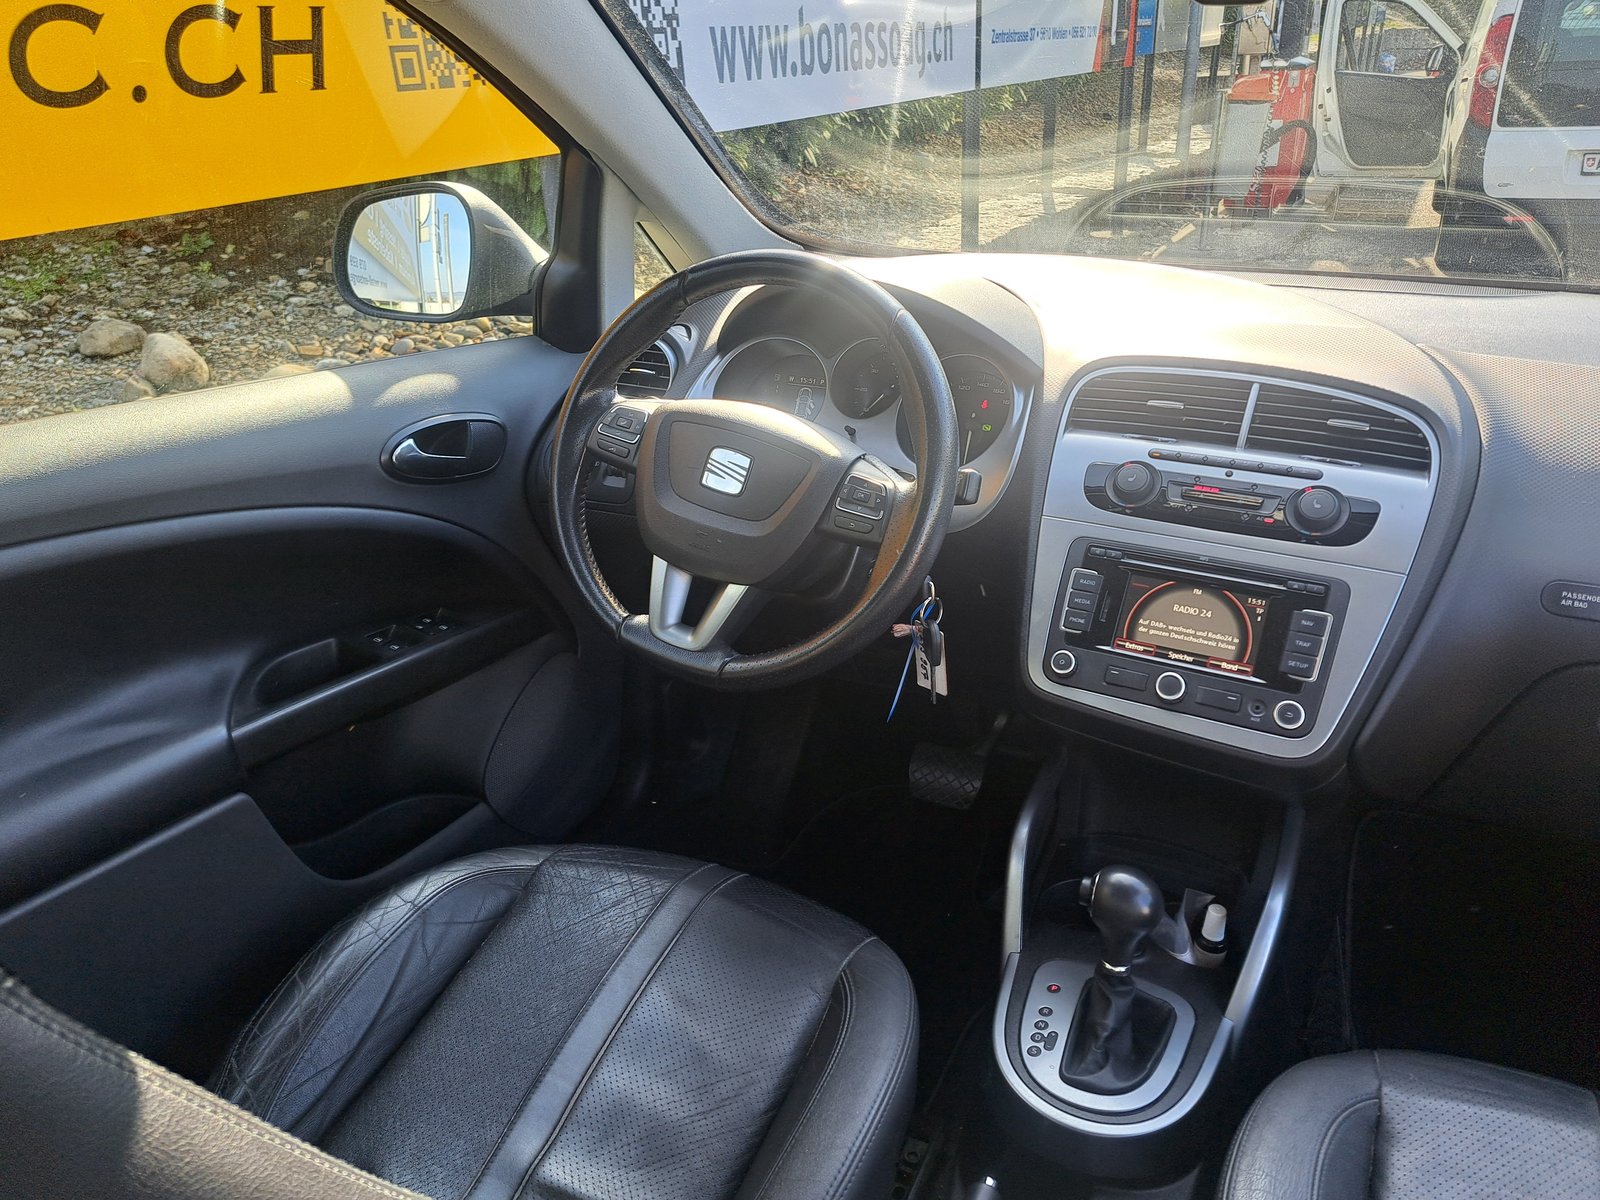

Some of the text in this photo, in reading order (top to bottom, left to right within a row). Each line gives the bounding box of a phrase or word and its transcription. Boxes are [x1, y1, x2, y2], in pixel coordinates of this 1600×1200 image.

[991, 28, 1029, 44] Zentralstrasse
[9, 4, 328, 109] C.CH
[800, 376, 816, 385] 15:51
[1079, 578, 1096, 586] RADIO
[1247, 597, 1266, 606] 15:51
[1560, 599, 1588, 609] AIR BAG
[1172, 603, 1213, 618] RADIO 24
[1069, 616, 1086, 624] PHONE
[1138, 618, 1240, 644] Auf DAB+ wechseln und Radio24 in
[1148, 628, 1170, 639] ganzen
[1169, 631, 1218, 648] Deutschschweiz
[1218, 641, 1236, 651] hören
[1295, 639, 1312, 648] TRAF
[1125, 641, 1145, 652] Extras
[1167, 651, 1195, 663] Speicher
[1221, 661, 1240, 672] Band
[1287, 660, 1309, 669] SETUP
